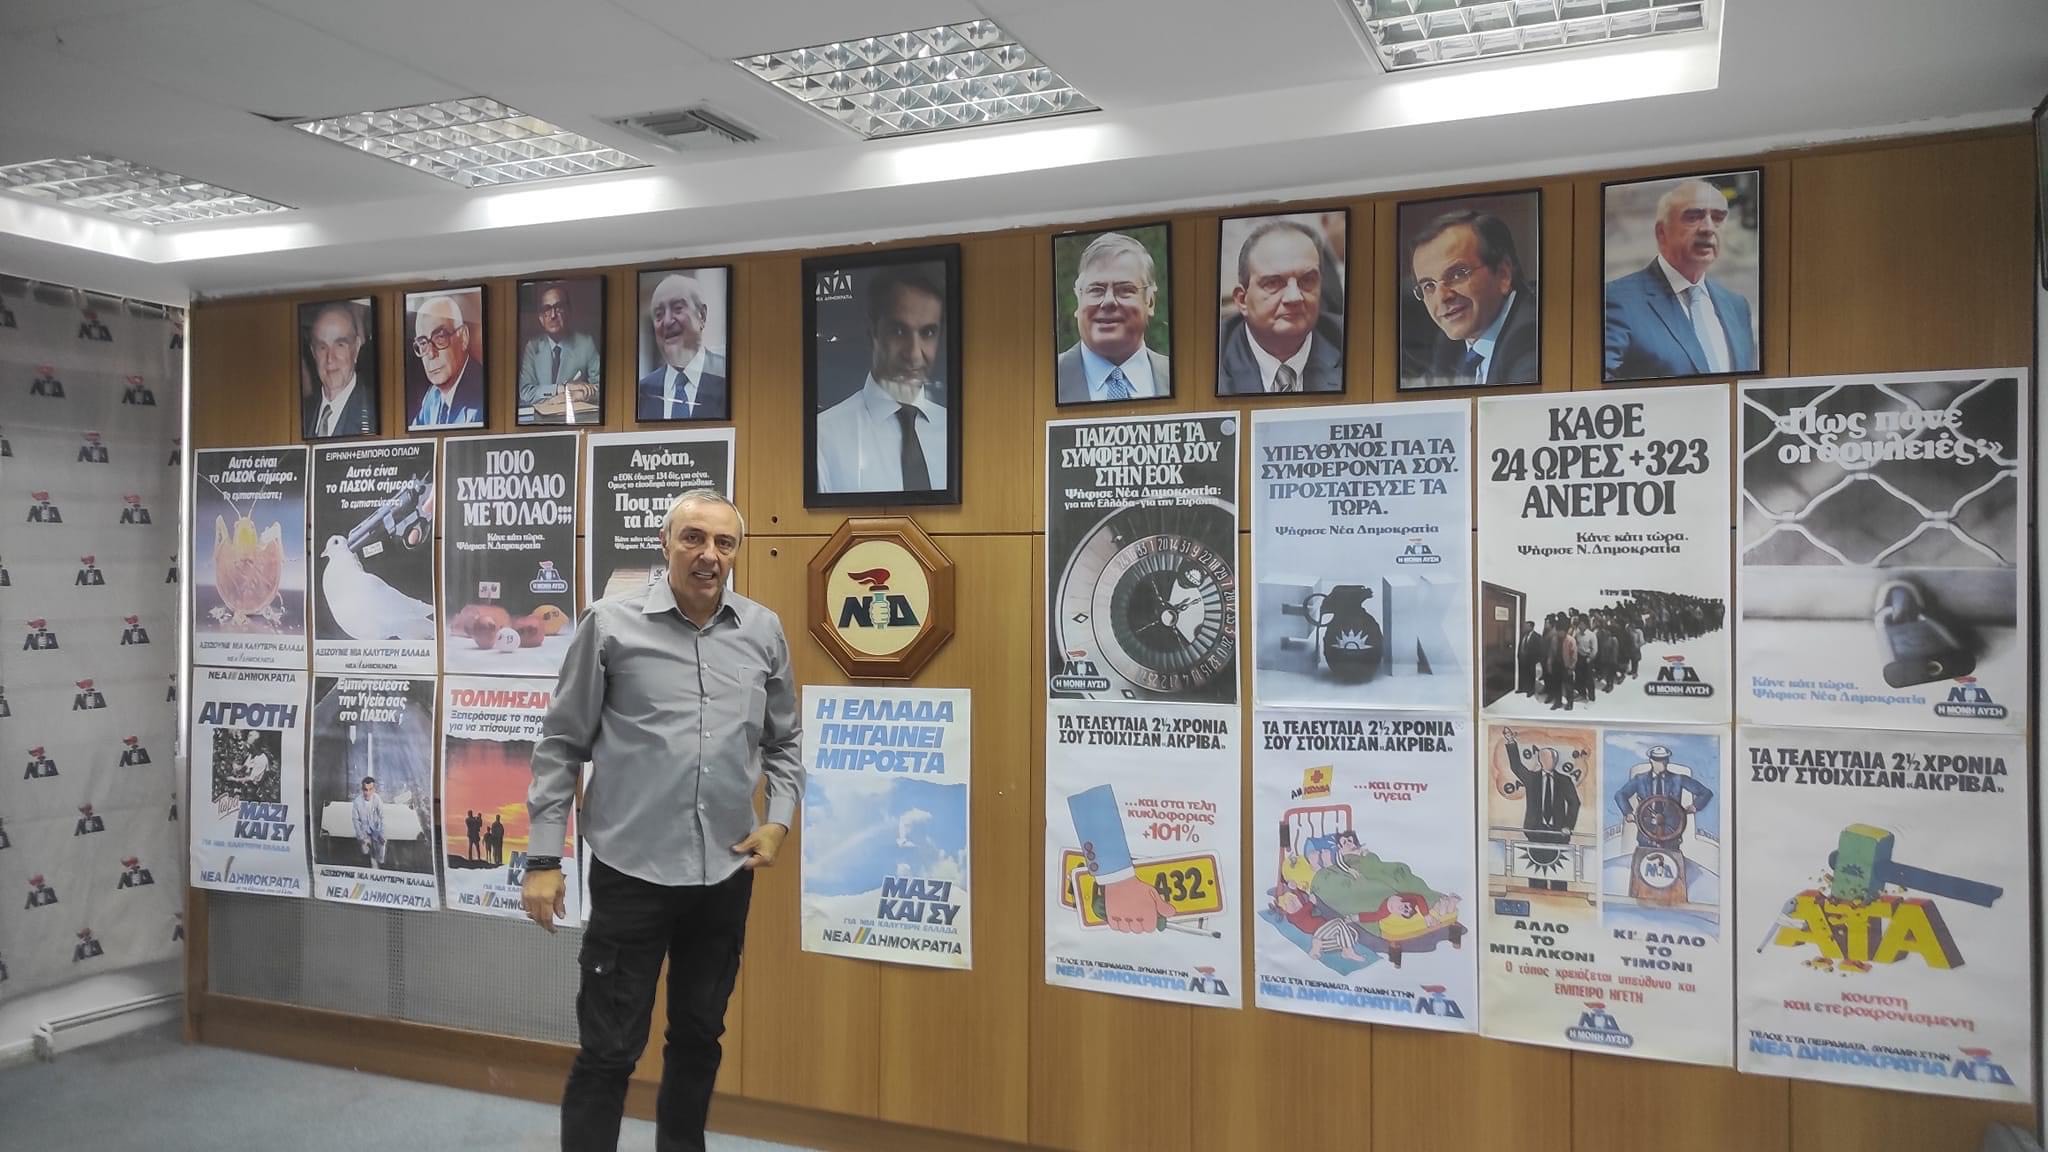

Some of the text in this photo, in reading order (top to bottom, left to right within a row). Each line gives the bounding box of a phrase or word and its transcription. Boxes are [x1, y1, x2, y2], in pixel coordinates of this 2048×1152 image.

[1329, 422, 1383, 440] ΕΙΣΑΙ
[1549, 403, 1645, 441] ΚΑΘΕ
[1075, 421, 1206, 447] ΠΑΙΖΟΥΝ ΜΕ ΤΑ
[392, 447, 419, 457] ΟΠΛΩΝ
[1061, 441, 1221, 468] ΣΥΜΦΕΡΟΝΤΑ ΣΟΥ
[1262, 438, 1455, 462] ΥΠΕΥΘΥΝΟΣ ΓΙΑ ΤΑ
[1491, 438, 1710, 481] 24 ΩΡΕΣ +323
[1778, 443, 1811, 464] οι
[228, 456, 278, 469] Αυτό είναι
[486, 449, 535, 475] ΠΟΙΟ
[630, 449, 695, 471] Αγρότη,
[1261, 456, 1459, 479] ΣΥΜΦΕΡΟΝΤΑ ΣΟΥ.
[209, 474, 219, 483] το
[221, 471, 256, 483] ΠΑΣΟΚ
[347, 464, 398, 478] Αυτό είναι
[1095, 464, 1184, 487] ΣΤΗΝ ΕΟΚ
[326, 479, 375, 493] το ΠΑΣΟΚ
[457, 474, 566, 501] ΣΥΜΒΟΛΑΙΟ
[1064, 487, 1140, 500] Ψήφισε Νέα
[1269, 478, 1448, 499] ΠΡΟΣΤΑΤΕΥΣΕ ΤΑ
[1328, 499, 1388, 516] ΤΩΡΑ.
[1521, 480, 1676, 518] ΑΝΕΡΓΟΙ
[464, 501, 517, 527] ΜΕ ΤΟ
[624, 515, 641, 528] τα
[1275, 524, 1439, 537] Ψήφισε Νέα Δημοκρατία
[1577, 532, 1643, 542] Κάνε κάτι
[1517, 545, 1574, 557] Ψήφισε
[208, 671, 296, 682] ΝΕΑ ΔΗΜΟΚΡΑΤΙΑ
[1056, 679, 1107, 689] Η ΜΟΝΗ ΛΥΣΗ
[1752, 676, 1785, 687] Κάνε
[1648, 685, 1655, 693] Η
[1685, 686, 1710, 695] ΛΥΣΗ
[1810, 690, 1837, 701] Νέα
[1840, 691, 1926, 705] Δημοκρατία
[338, 695, 407, 710] την σας
[816, 698, 954, 723] Η ΕΛΛΑΔΑ
[198, 701, 298, 728] ΑΓΡΟΤΗ
[340, 711, 358, 721] στο
[451, 710, 507, 723] Ξεπεράσαμε
[449, 722, 463, 733] για
[465, 723, 476, 731] να
[524, 726, 534, 734] το
[1057, 715, 1228, 735] ΤΑ ΤΕΛΕΥΤΑΙΑ ΧΡΟΝΙΑ
[1262, 720, 1455, 736] ΤΑ ΤΕΛΕΥΤΑΙΑ ΧΡΟΝΙΑ
[820, 723, 945, 749] ΠΗΓΑΙΝΕΙ
[1059, 730, 1161, 747] ΣΟΥ ΣΤΟΙΧΙΣΑΝ
[1264, 735, 1378, 751] ΣΟΥ ΣΤΟΙΧΙΣΑΝ
[815, 747, 945, 774] ΜΠΡΟΣΤΑ
[1749, 747, 2008, 776] ΤΑ ΤΕΛΕΥΤΑΙΑ ΧΡΟΝΙΑ
[1752, 766, 1905, 789] ΣΟΥ ΣΤΟΙΧΙΣΑΝ
[1373, 792, 1412, 802] υγεια
[1392, 782, 1428, 793] στην
[238, 801, 289, 822] ΜΑΖΙ
[1161, 798, 1217, 813] στα τελη
[1127, 808, 1215, 825] κυκλοφοριας
[234, 821, 295, 842] ΚΑΙ ΣΥ
[1142, 822, 1200, 843] +101%
[201, 870, 301, 889] ΝΕΑ ΔΗΜΟΚΡΑΤΙΑ
[881, 876, 953, 902] ΜΑΖΙ
[1154, 867, 1206, 903] 432
[326, 886, 432, 908] ΝΕΑ ΔΗΜΟΚΡΑΤΙΑ
[459, 892, 480, 905] ΝΕΑ
[877, 898, 961, 926] ΚΑΙ ΣΥ
[1513, 920, 1569, 934] ΑΛΛΟ
[1775, 889, 1965, 969] ΑΤΑ
[822, 929, 963, 955] ΝΕΑ ΔΗΜΟΚΡΑΤΙΑ
[1530, 935, 1555, 946] ΤΟ
[1645, 932, 1706, 947] ΑΛΛΟ
[1490, 943, 1595, 962] ΜΠΑΛΚΟΝΙ
[1645, 945, 1672, 957] ΤΟ
[1620, 956, 1693, 973] ΤΙΜΟΝΙ
[1056, 964, 1186, 992] ΝΕΑ ΔΗΜΟΚΡΑΤΙΑ
[1505, 961, 1513, 972] Ο
[1520, 963, 1550, 977] τόπος
[1678, 982, 1696, 992] και
[1260, 982, 1412, 1013] ΝΕΑ ΔΗΜΟΚΡΑΤΙΑ
[1554, 983, 1643, 1004] ΕΜΠΕΙΡΟ ΗΓΕΤΗ
[1783, 999, 1976, 1032] και ετεροχρονισμενη
[1606, 1033, 1629, 1044] ΛΥΣΗ
[1750, 1038, 1950, 1078] ΝΕΑ ΔΗΜΟΚΡΑΤΙΑ
